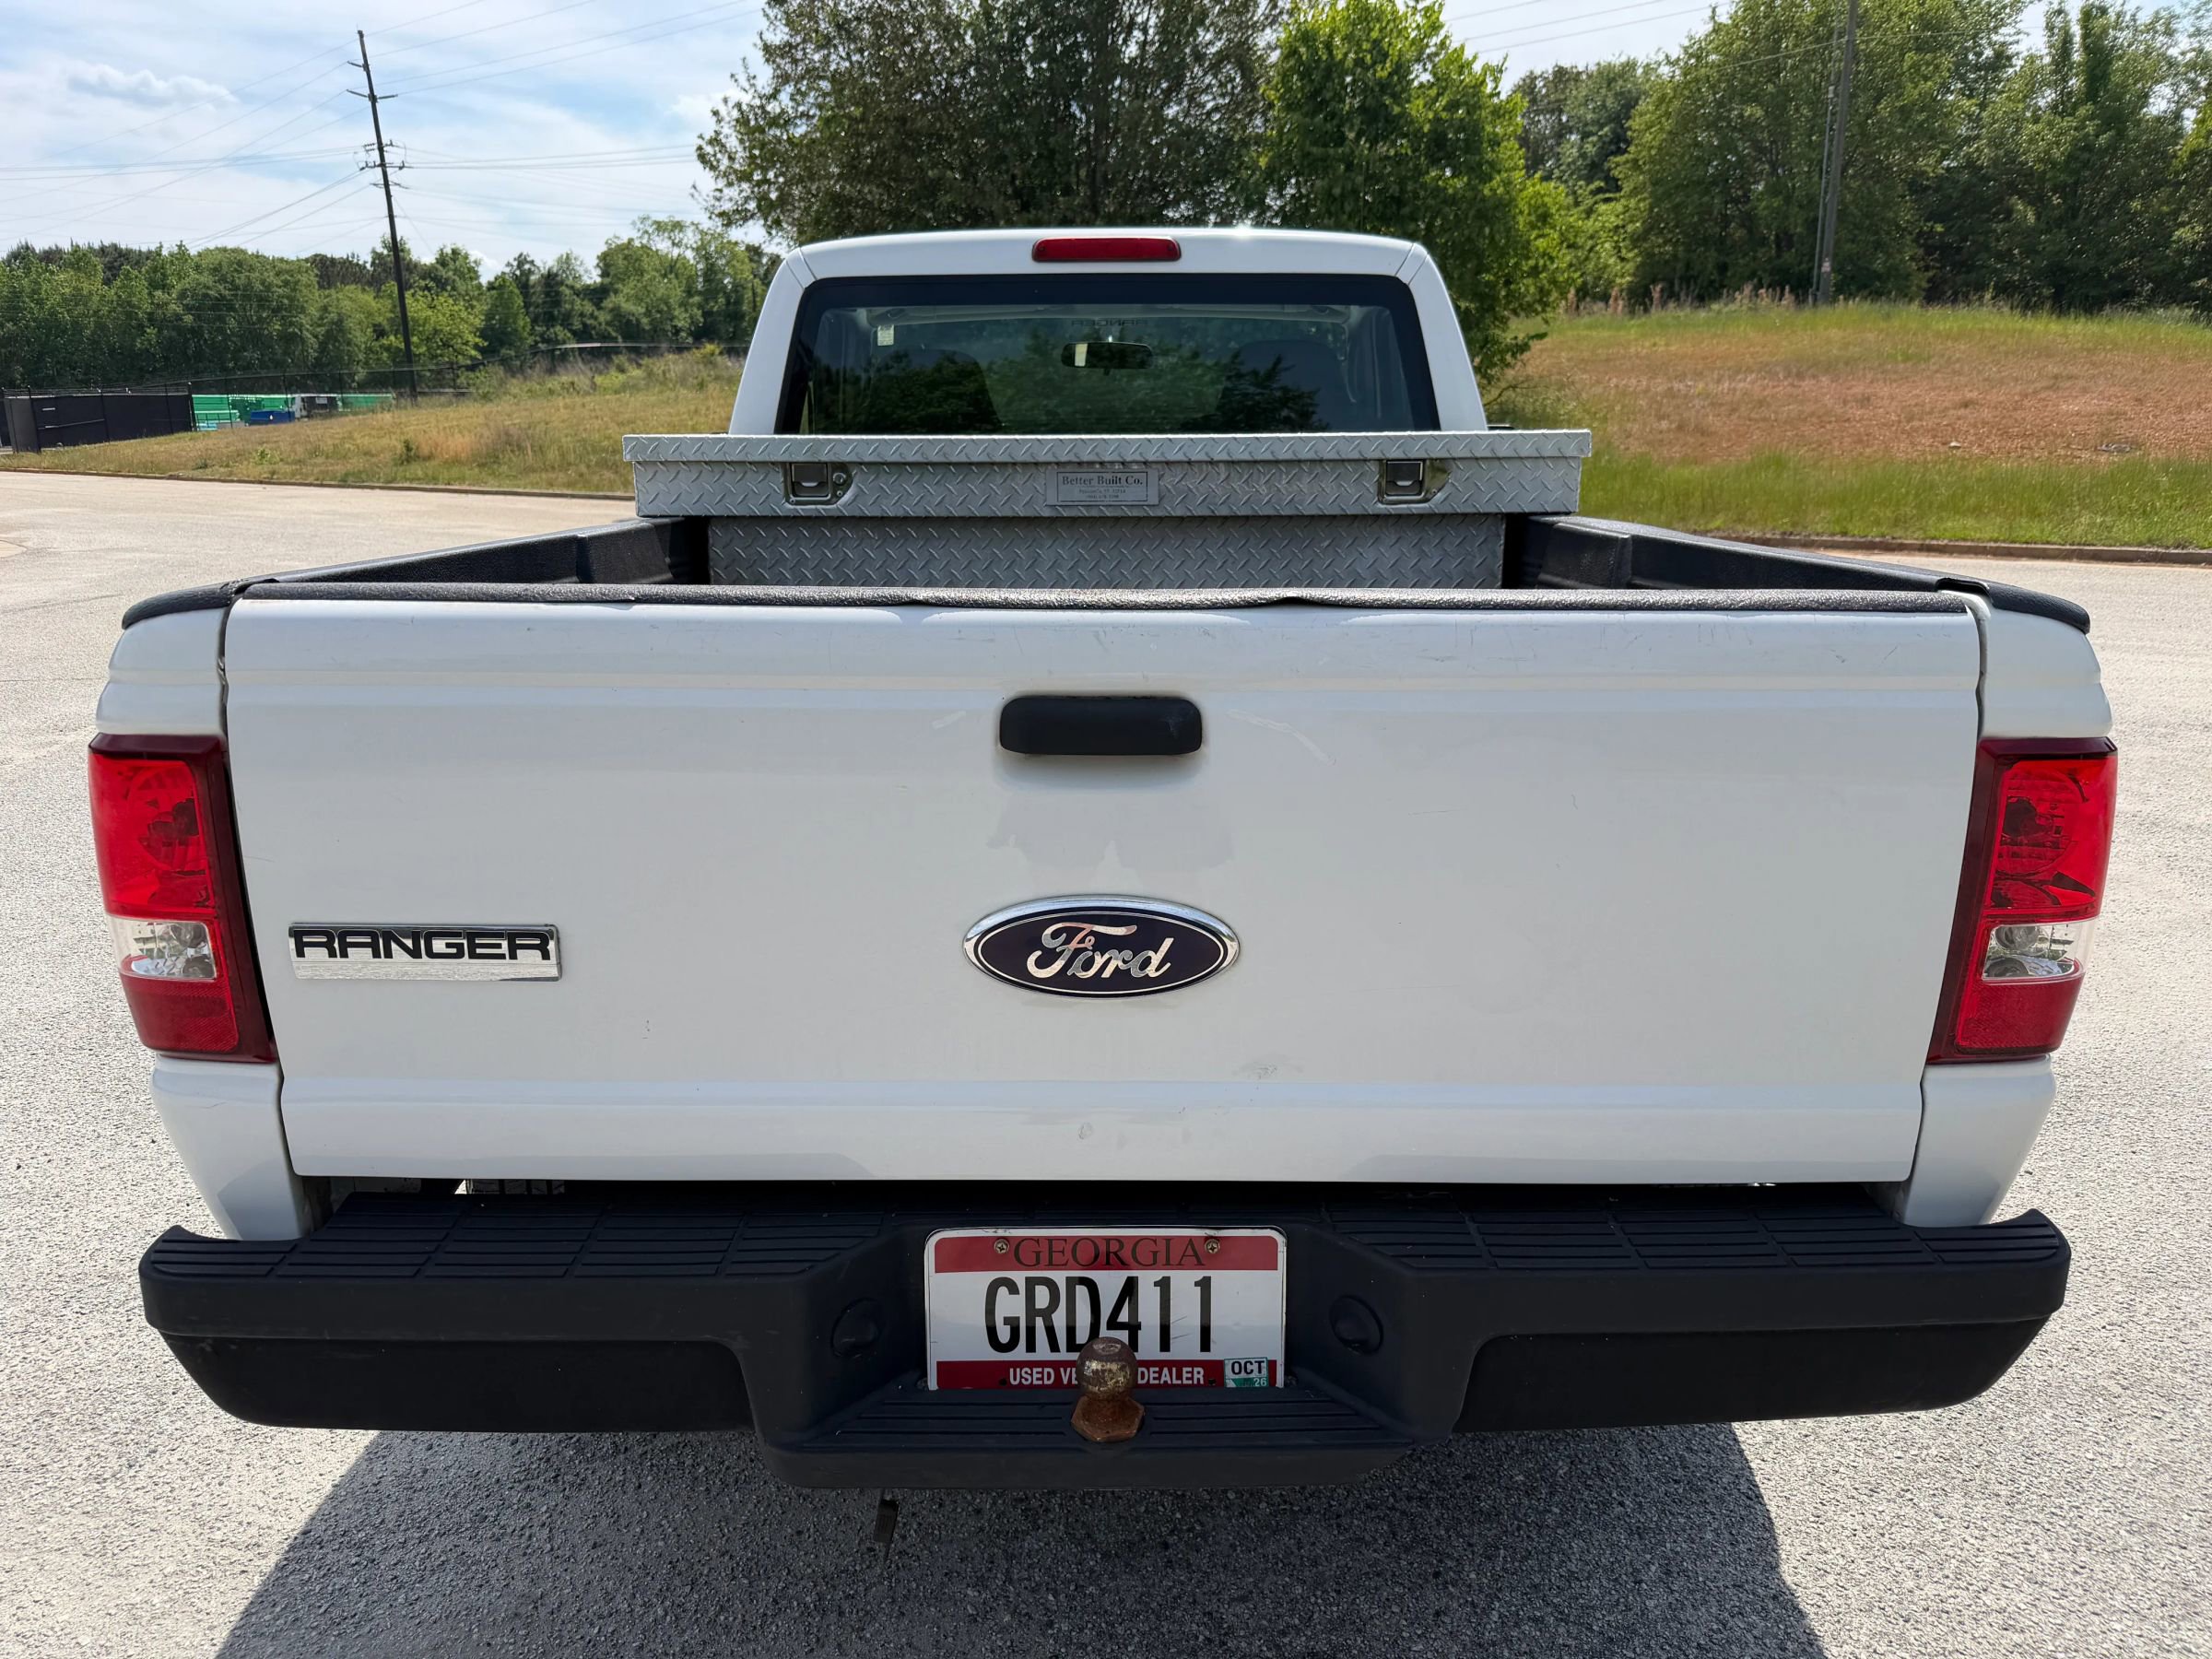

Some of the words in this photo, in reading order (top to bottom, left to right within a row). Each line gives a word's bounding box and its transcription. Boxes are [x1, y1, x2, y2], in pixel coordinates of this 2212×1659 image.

[1062, 476, 1093, 486] Better
[1097, 476, 1122, 486] Built
[1125, 476, 1143, 486] Co.
[292, 929, 552, 960] RANGER
[1026, 922, 1174, 979] Ford
[1014, 1237, 1206, 1267] GEORGIA
[984, 1276, 1212, 1353] GRD411
[1009, 1367, 1055, 1384] USED
[1137, 1367, 1205, 1384] DEALER
[1230, 1359, 1265, 1375] OCT
[1253, 1377, 1267, 1387] 26
